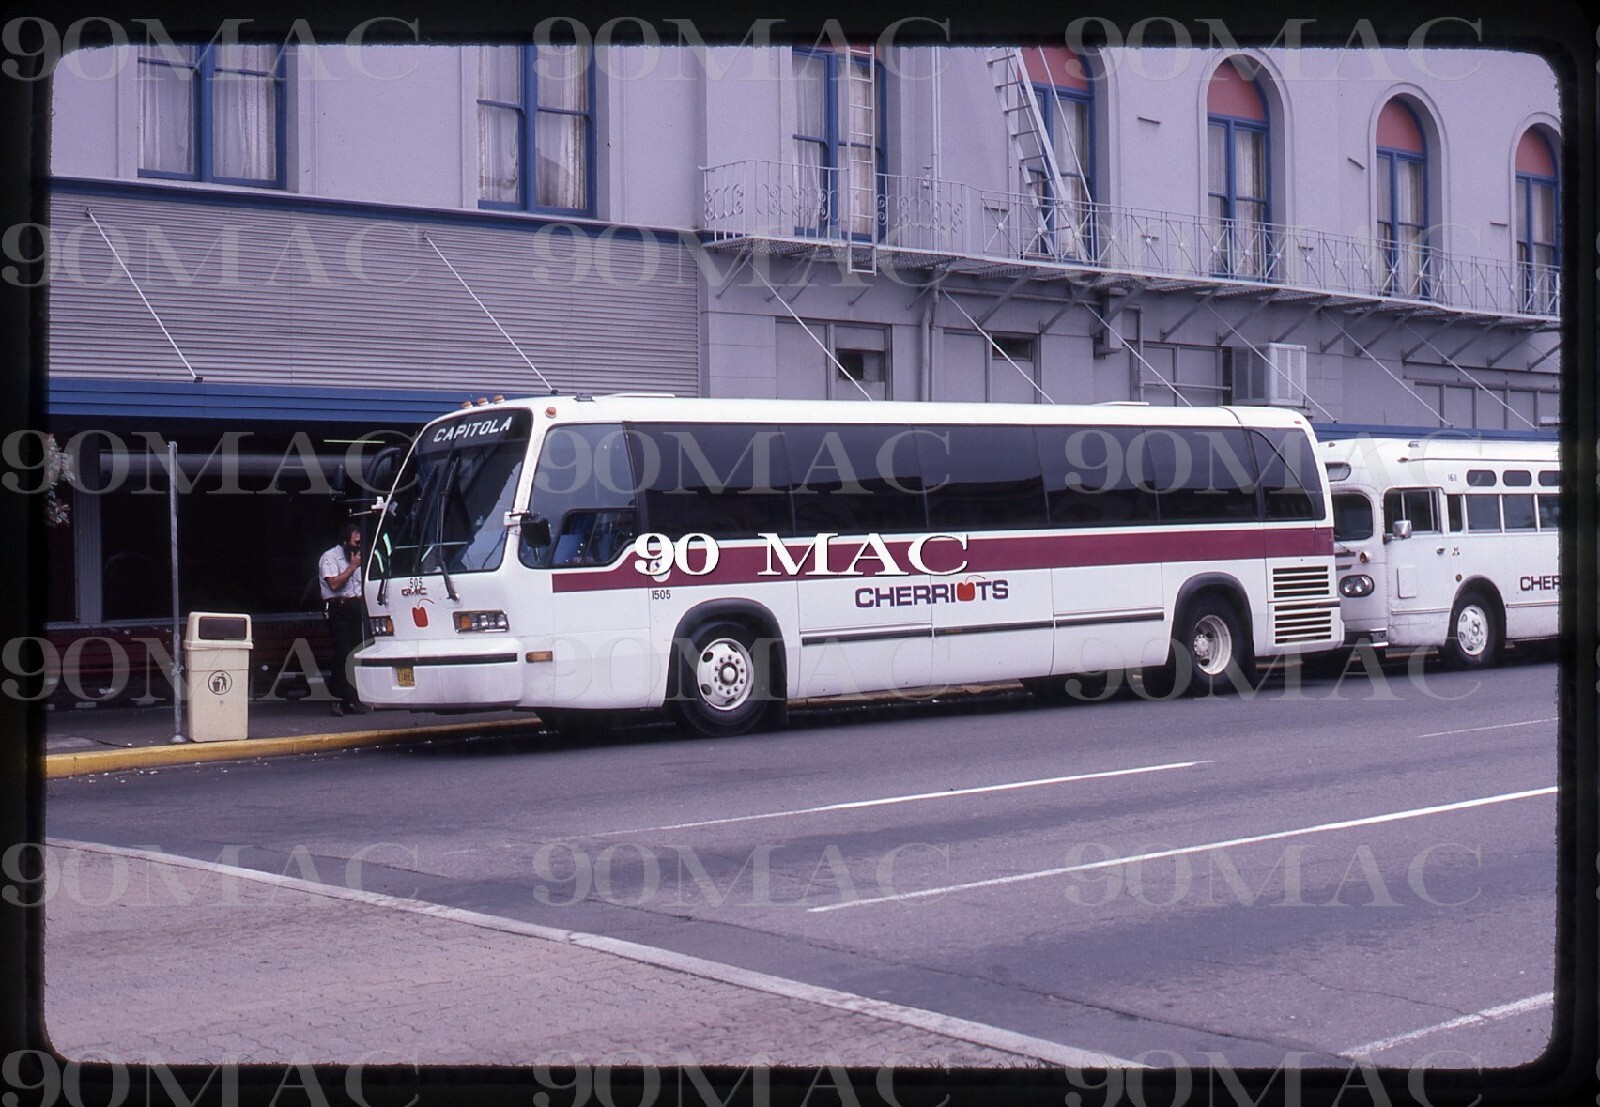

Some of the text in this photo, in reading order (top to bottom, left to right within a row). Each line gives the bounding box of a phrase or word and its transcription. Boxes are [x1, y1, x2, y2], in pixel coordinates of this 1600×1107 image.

[433, 416, 513, 443] CAPITOLA
[401, 587, 428, 597] GMC
[651, 589, 671, 600] 1505
